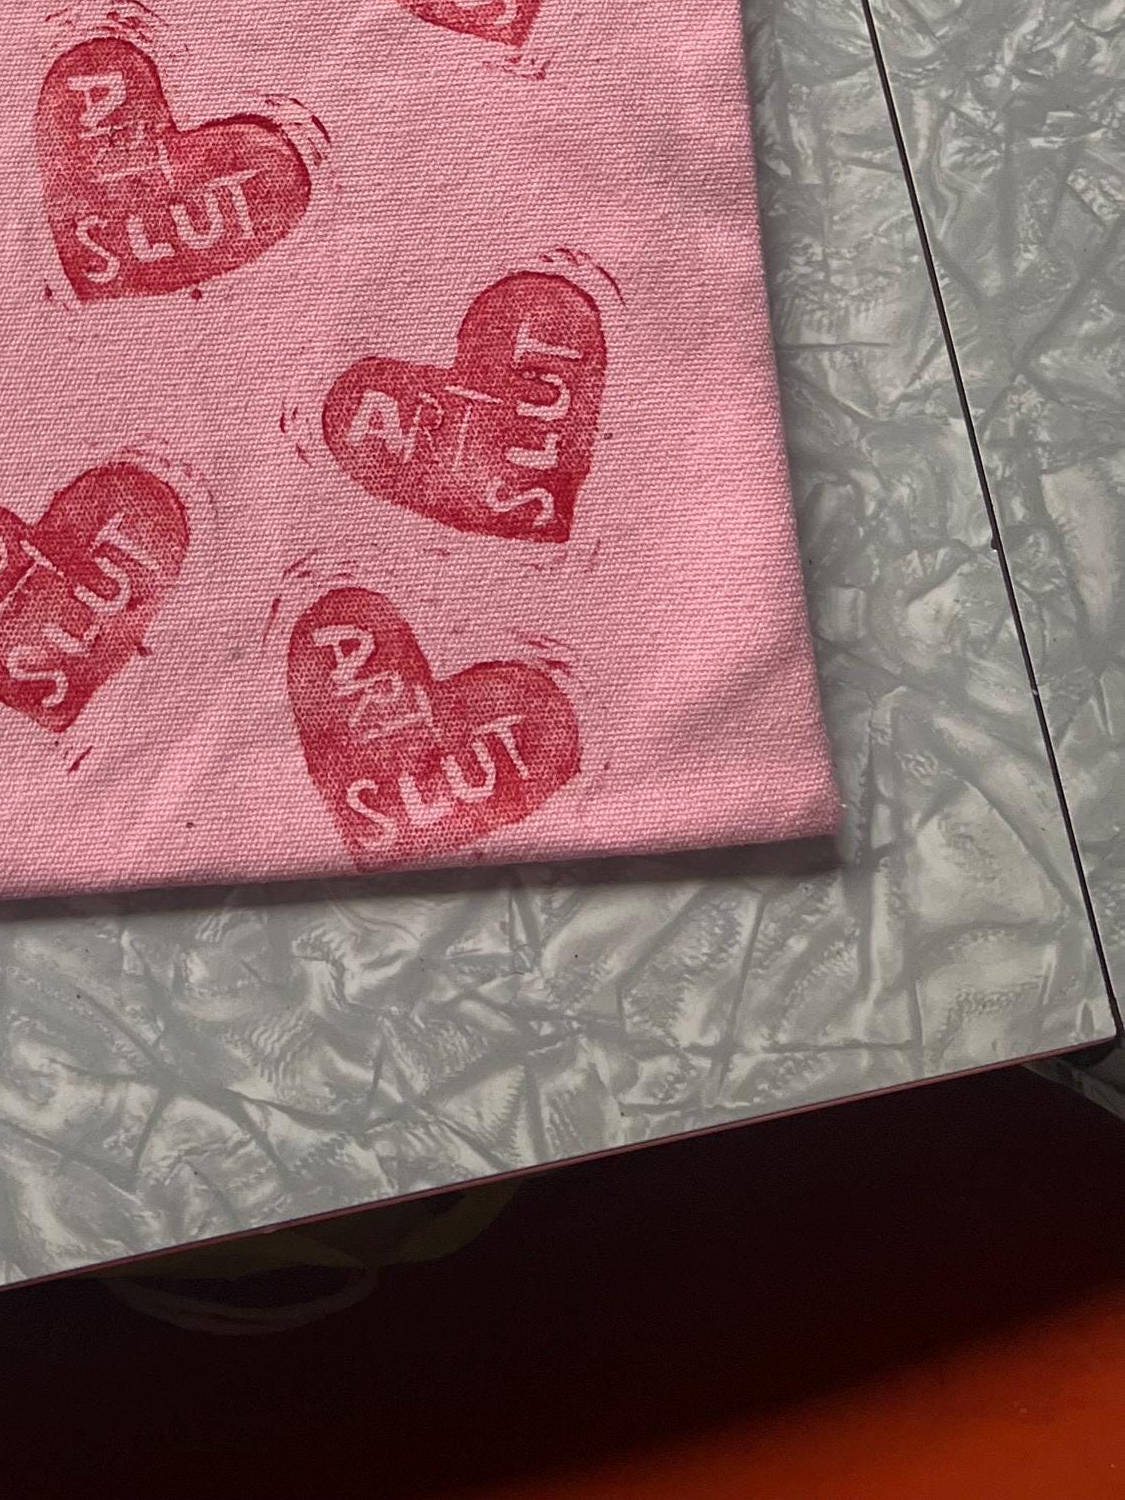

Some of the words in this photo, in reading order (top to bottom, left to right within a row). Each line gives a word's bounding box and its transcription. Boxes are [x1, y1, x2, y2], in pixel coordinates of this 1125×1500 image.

[65, 70, 175, 185] ART
[75, 168, 263, 285] SLUT
[345, 384, 505, 474] ART
[484, 320, 584, 528] SLUT
[5, 512, 161, 708] SLUT
[311, 625, 444, 744] ART
[346, 713, 530, 852] SLUT
